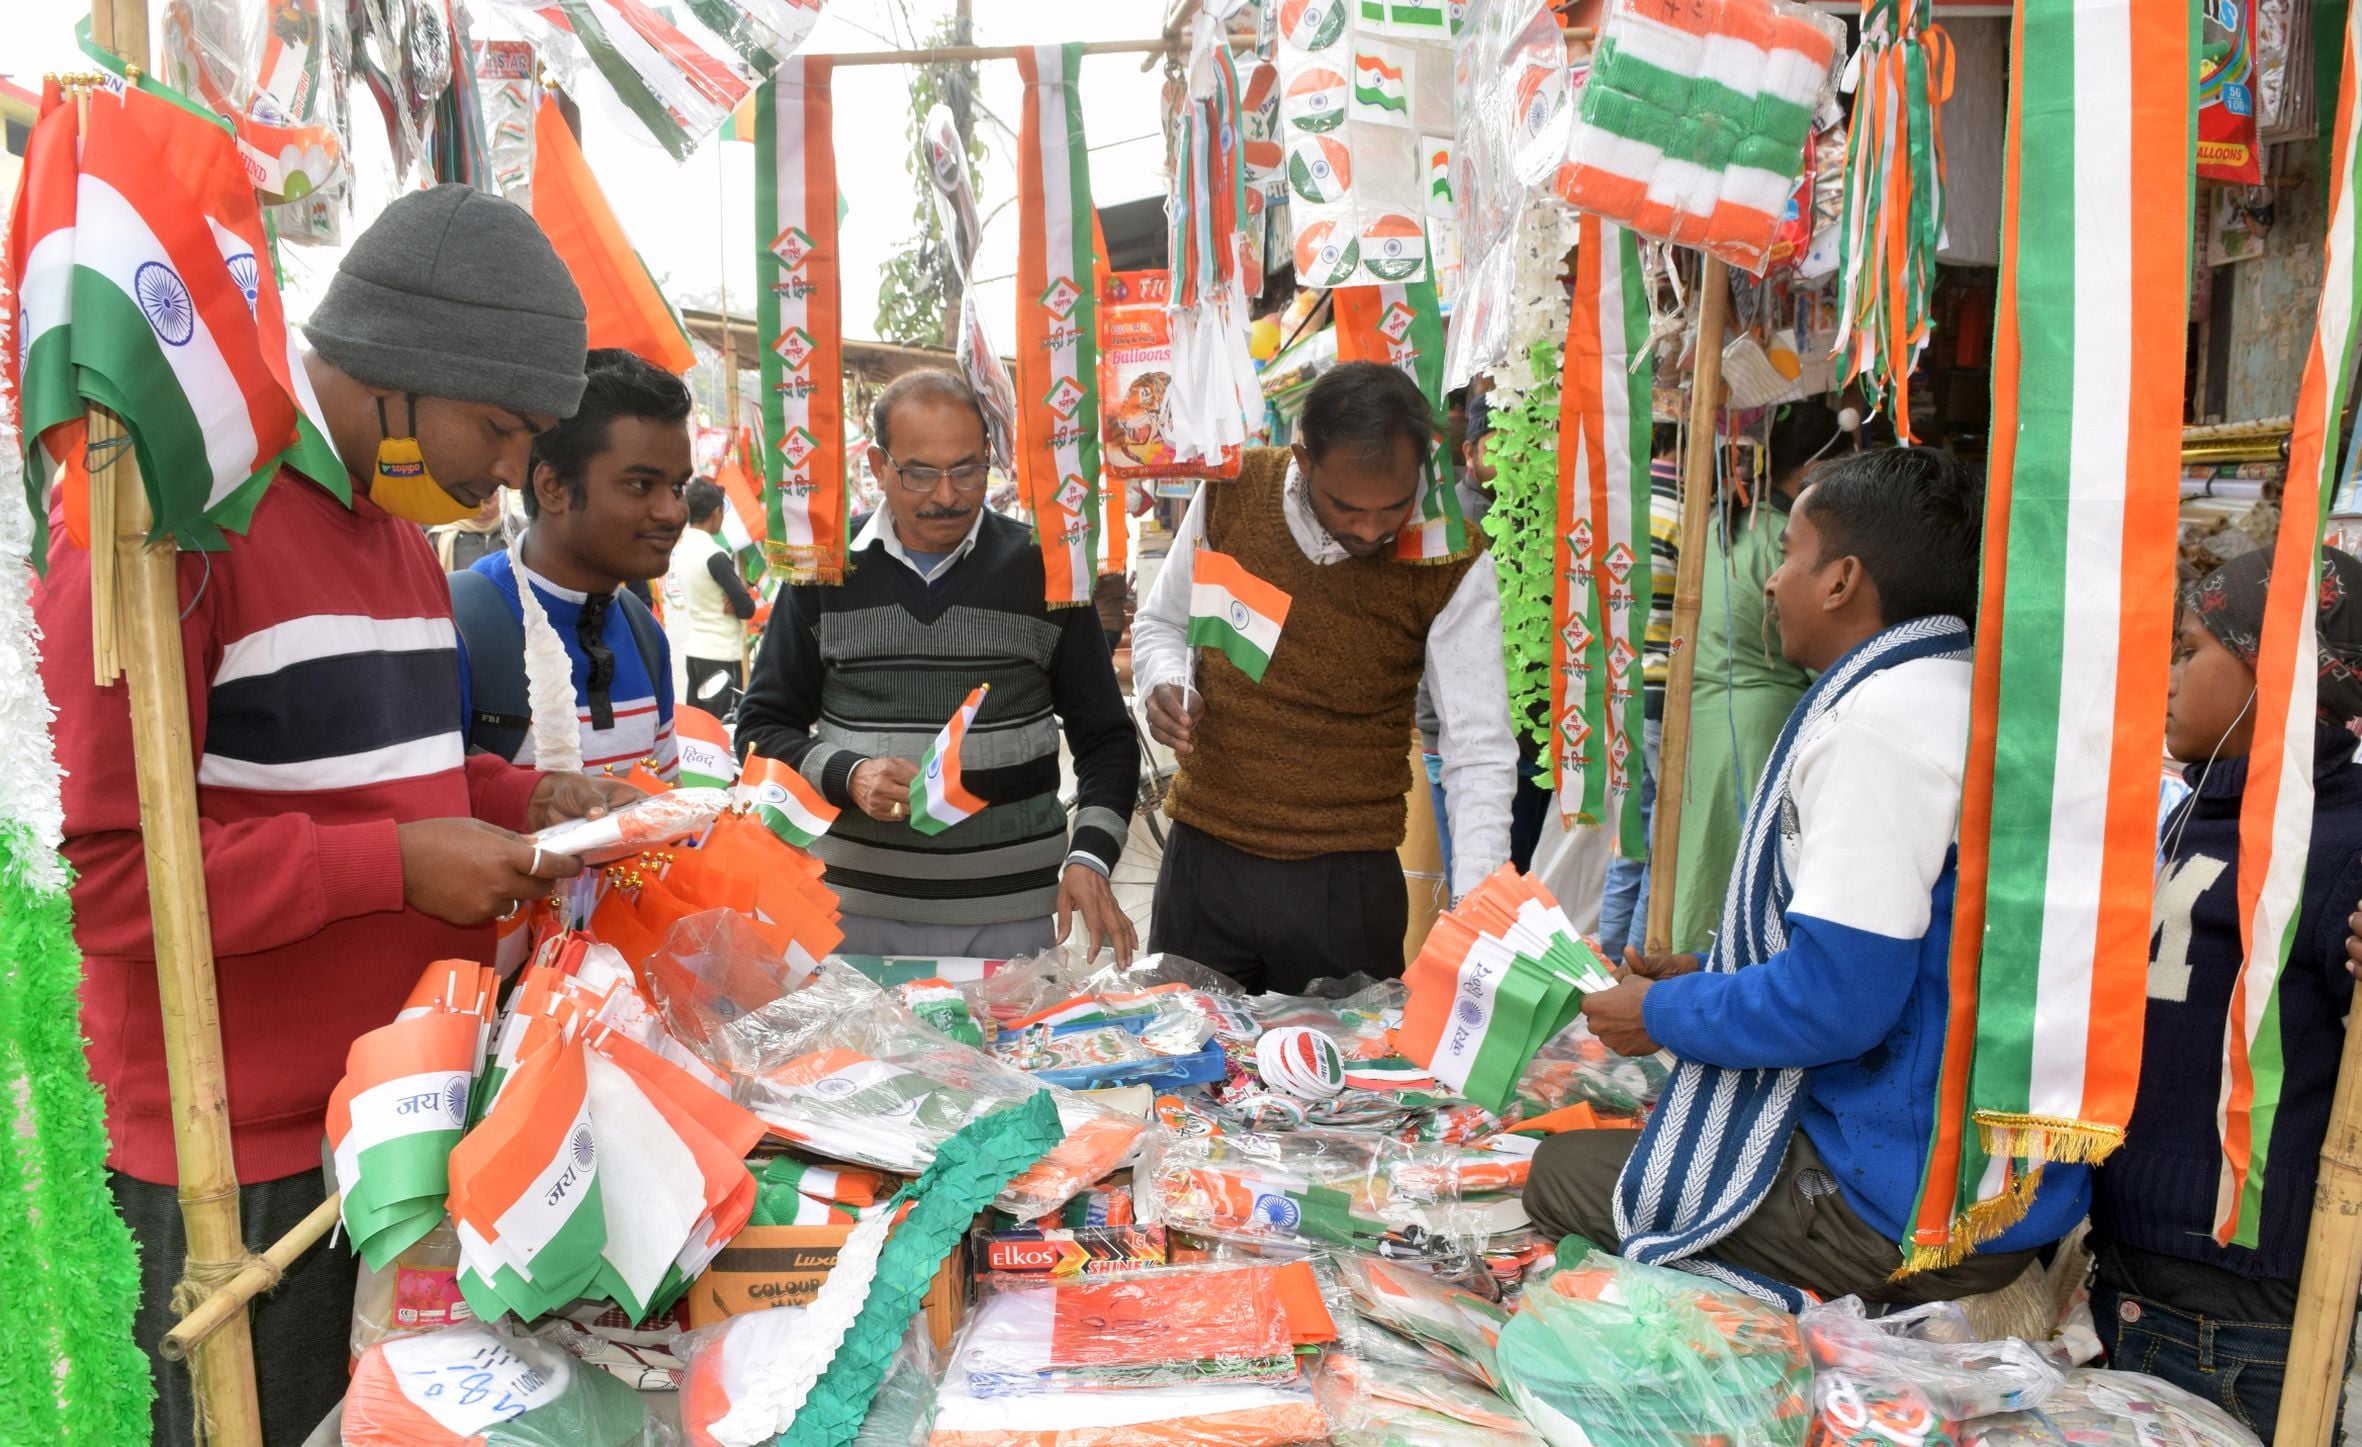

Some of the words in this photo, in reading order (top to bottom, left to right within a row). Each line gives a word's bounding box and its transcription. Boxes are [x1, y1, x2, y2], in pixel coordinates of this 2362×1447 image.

[2229, 86, 2242, 98] 50
[2197, 145, 2243, 161] ALLOONS
[1112, 348, 1171, 365] Balloons
[482, 714, 500, 724] FBI
[682, 745, 714, 769] हिन्द
[1449, 1025, 1469, 1056] जय
[1463, 962, 1492, 999] हिन्द
[396, 1092, 440, 1115] जय
[544, 1163, 577, 1207] जय
[793, 1252, 839, 1267] Luxo
[1088, 1259, 1143, 1275] SHINE
